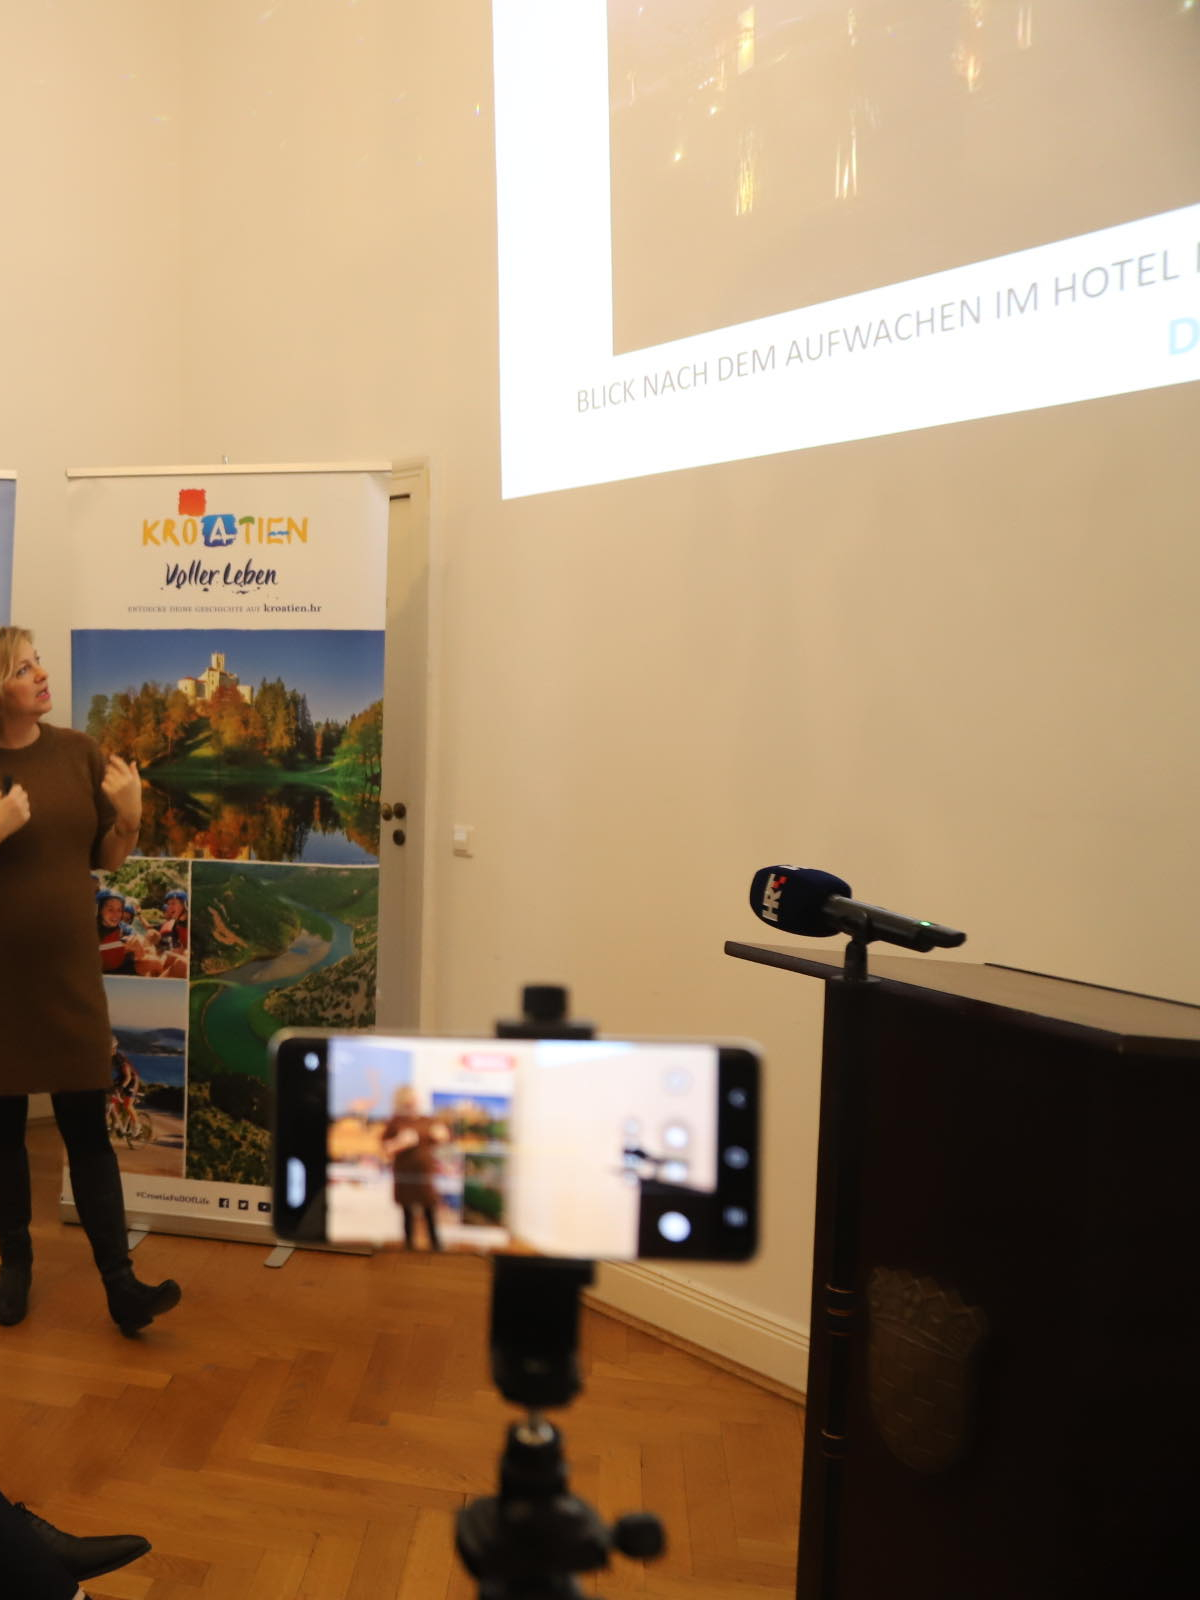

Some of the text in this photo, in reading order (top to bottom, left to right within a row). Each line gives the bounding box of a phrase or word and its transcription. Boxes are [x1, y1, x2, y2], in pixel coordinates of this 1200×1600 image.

[577, 378, 636, 413] BLICK
[643, 361, 708, 398] NACH
[717, 345, 776, 382] DEM
[785, 295, 981, 367] AUFWACHEN
[996, 281, 1038, 319] IM
[1054, 250, 1180, 307] HOTEL
[142, 514, 309, 547] KROATIEN
[165, 558, 278, 589] Voller Leben
[263, 603, 322, 613] kroatien.hr
